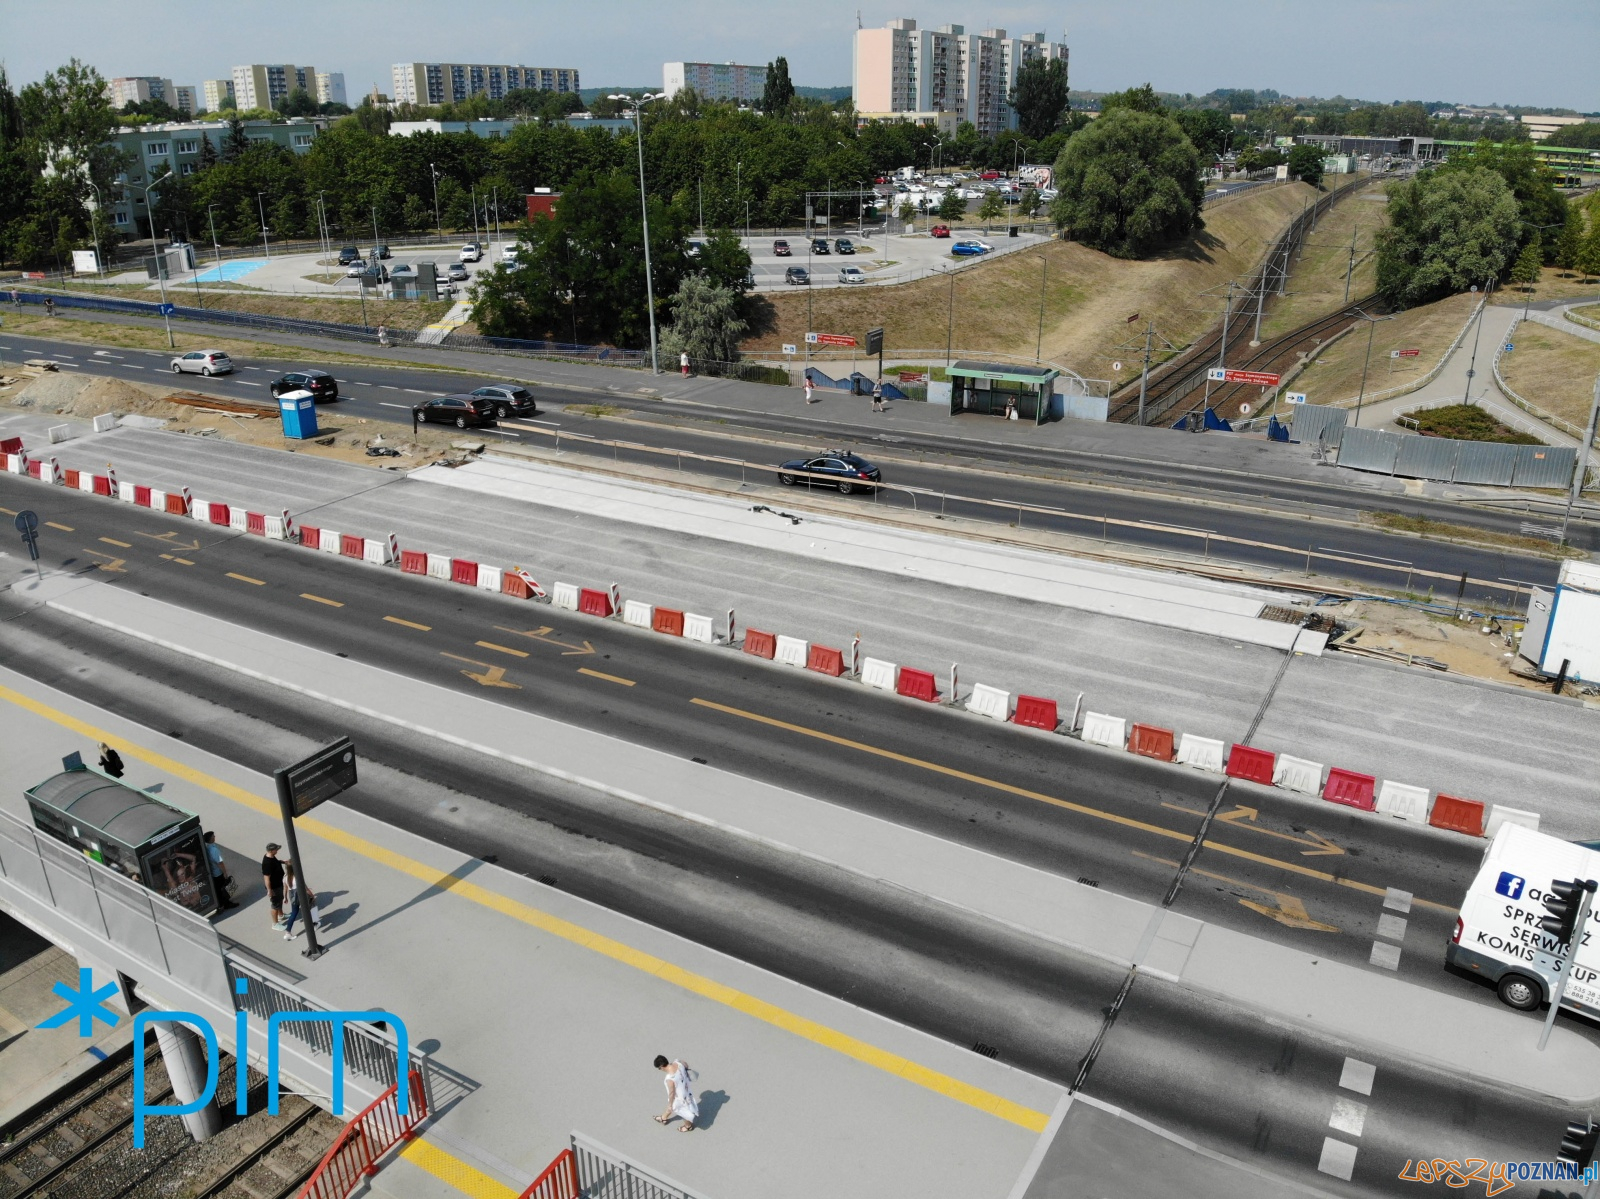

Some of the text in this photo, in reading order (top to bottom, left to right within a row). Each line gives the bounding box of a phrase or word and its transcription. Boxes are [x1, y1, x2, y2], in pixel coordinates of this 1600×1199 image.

[164, 881, 190, 898] Miasto
[1503, 905, 1591, 947] SPRZŻ
[1477, 931, 1535, 962] KOMIS
